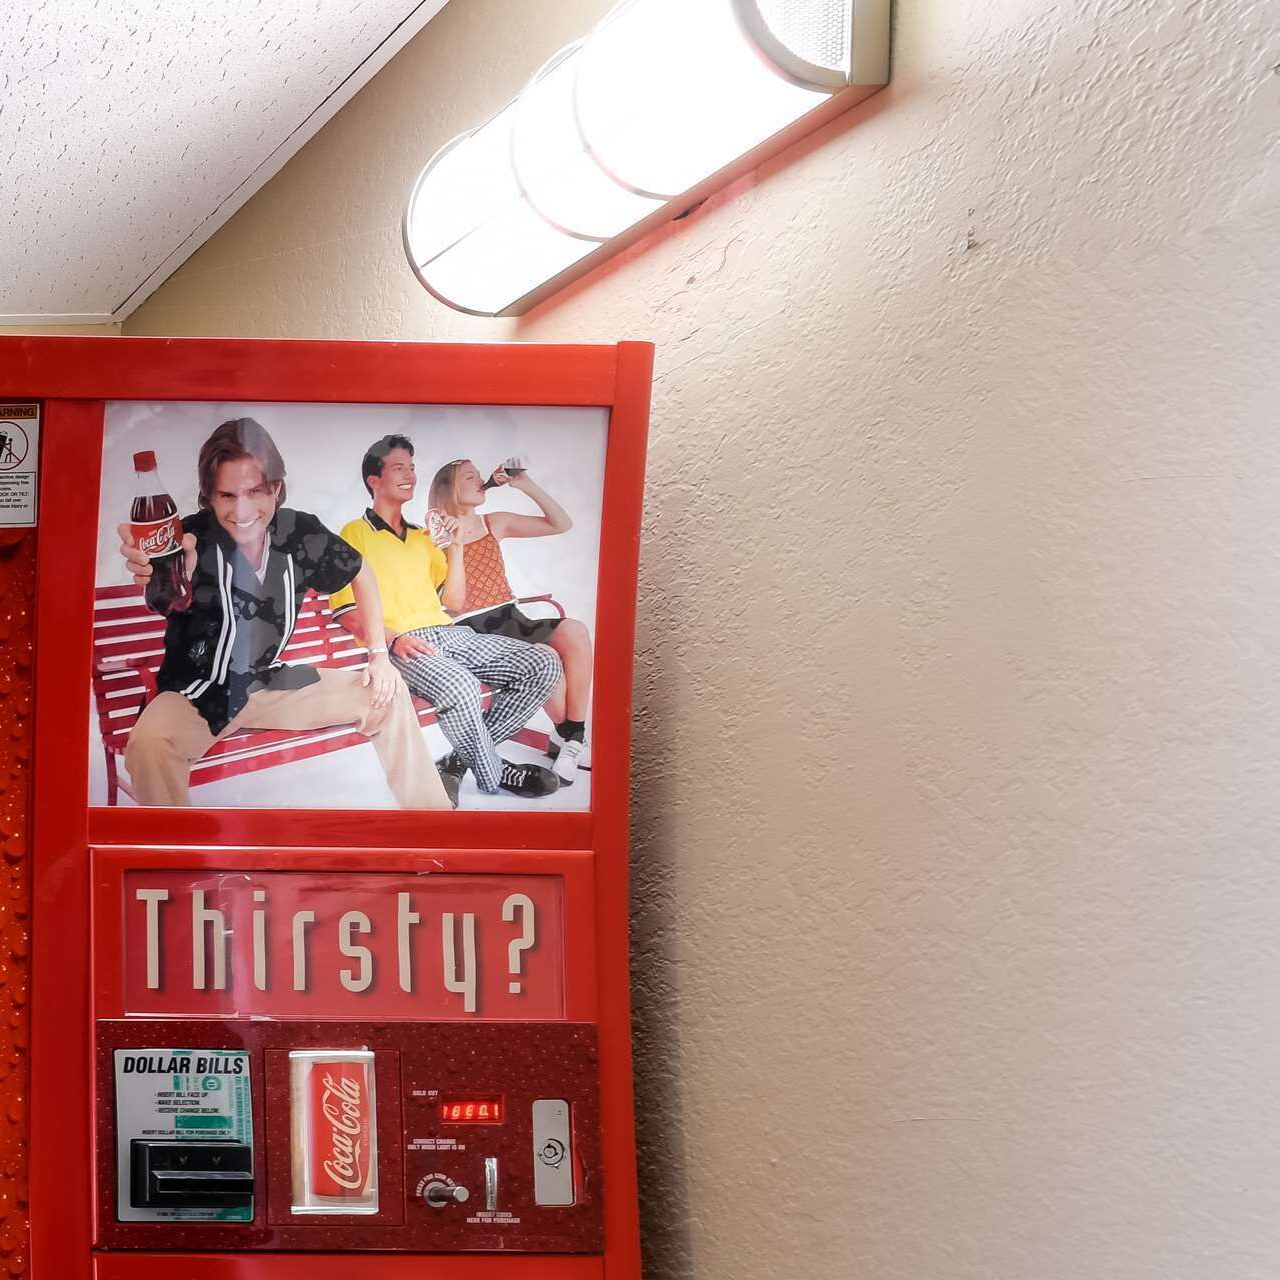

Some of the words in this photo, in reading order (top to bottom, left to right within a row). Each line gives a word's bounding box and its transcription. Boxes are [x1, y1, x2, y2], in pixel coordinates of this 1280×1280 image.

[136, 889, 536, 1013] Thirsty?
[123, 1056, 191, 1074] DOLLAR
[196, 1057, 244, 1074] BILLS
[322, 1071, 362, 1189] Coca-Cola
